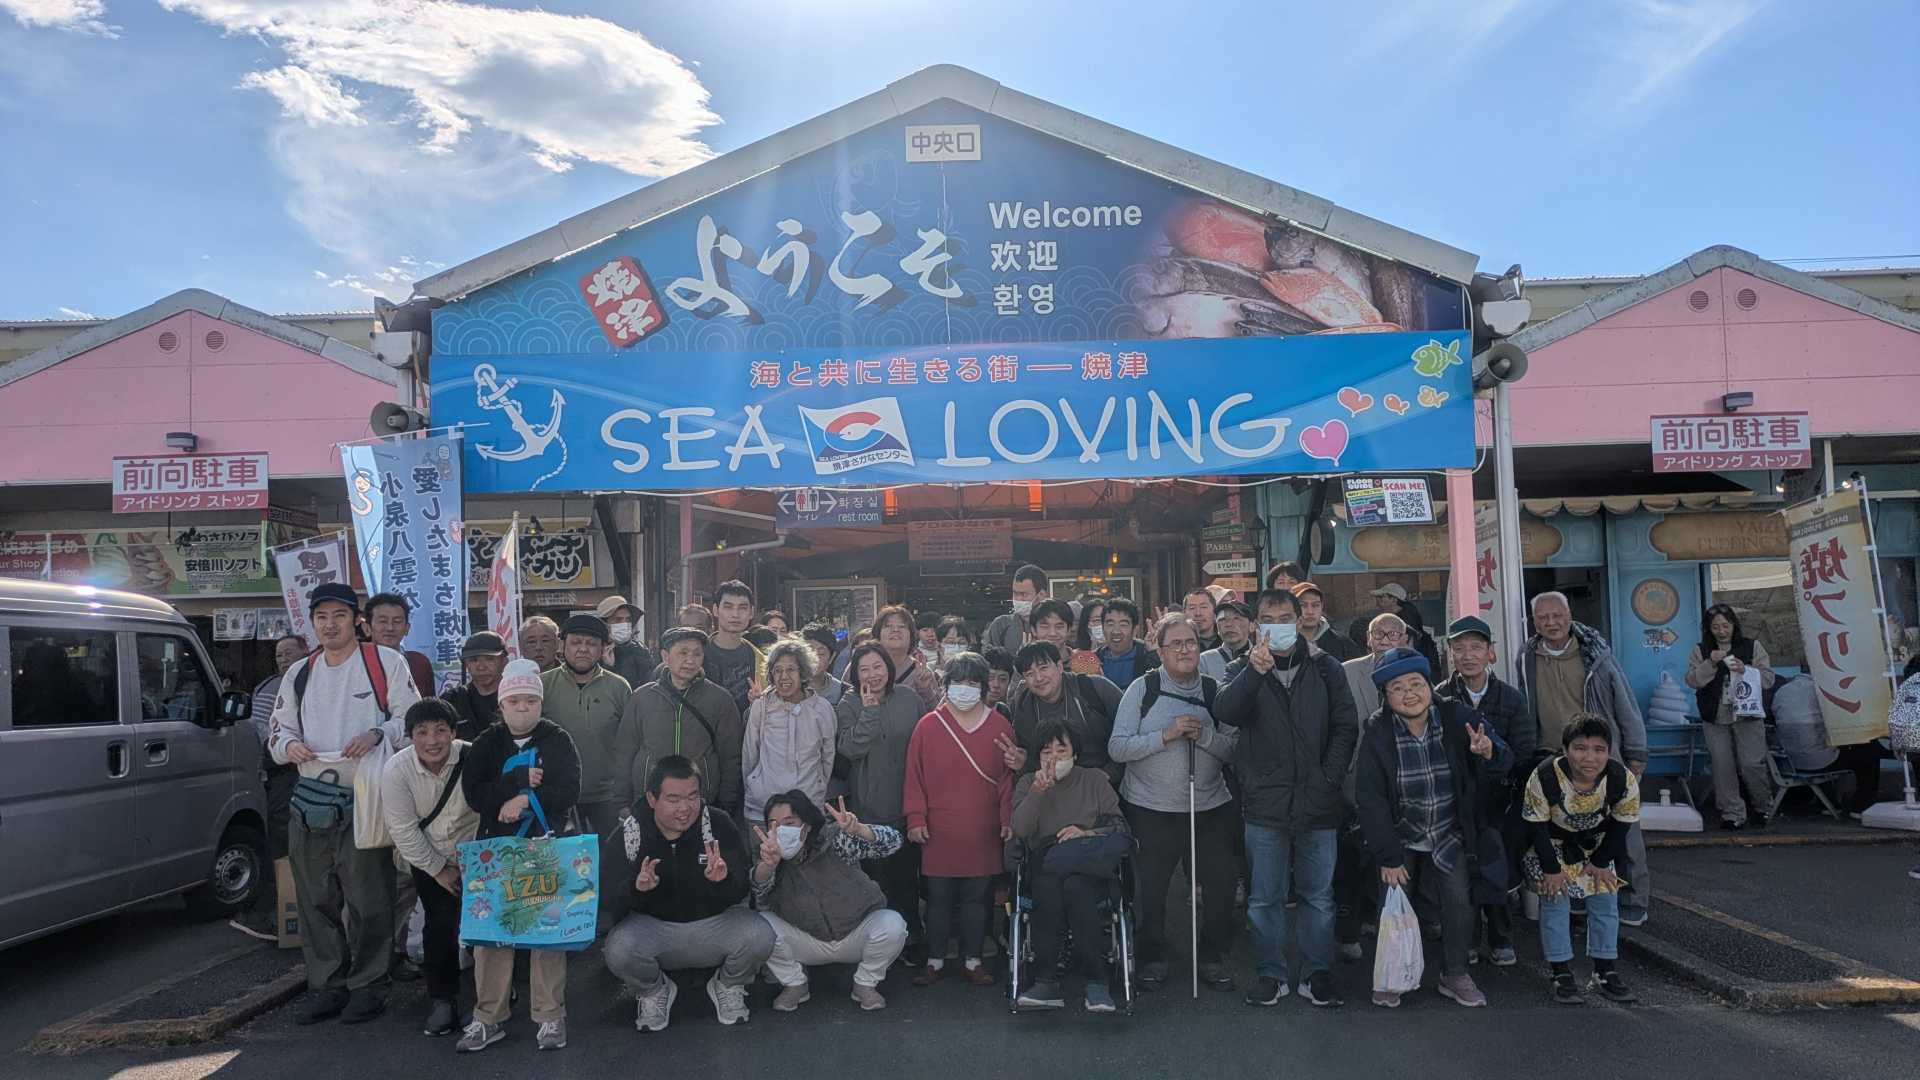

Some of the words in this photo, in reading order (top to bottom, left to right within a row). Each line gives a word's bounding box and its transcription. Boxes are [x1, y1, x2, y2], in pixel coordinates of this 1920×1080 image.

[911, 131, 976, 155] 中央口
[988, 201, 1142, 228] Welcome
[665, 211, 963, 317] ようこそ
[989, 241, 1059, 272] 欢迎
[993, 284, 1056, 315] 환영
[600, 404, 785, 472] SEA
[936, 390, 1292, 466] LOVING
[1660, 417, 1802, 451] 前向駐車
[122, 457, 259, 491] 前向駐車
[1663, 455, 1743, 470] アイドリング
[1750, 454, 1803, 468] ストップ
[1408, 482, 1425, 490] ME!
[122, 494, 200, 510] アイドリング
[207, 493, 260, 508] ストップ
[839, 494, 879, 509] 화장실
[838, 510, 857, 523] rest
[858, 509, 880, 522] room
[1206, 543, 1233, 552] PARIS
[184, 557, 262, 573] 安倍川ソフト
[502, 873, 559, 902] IZU
